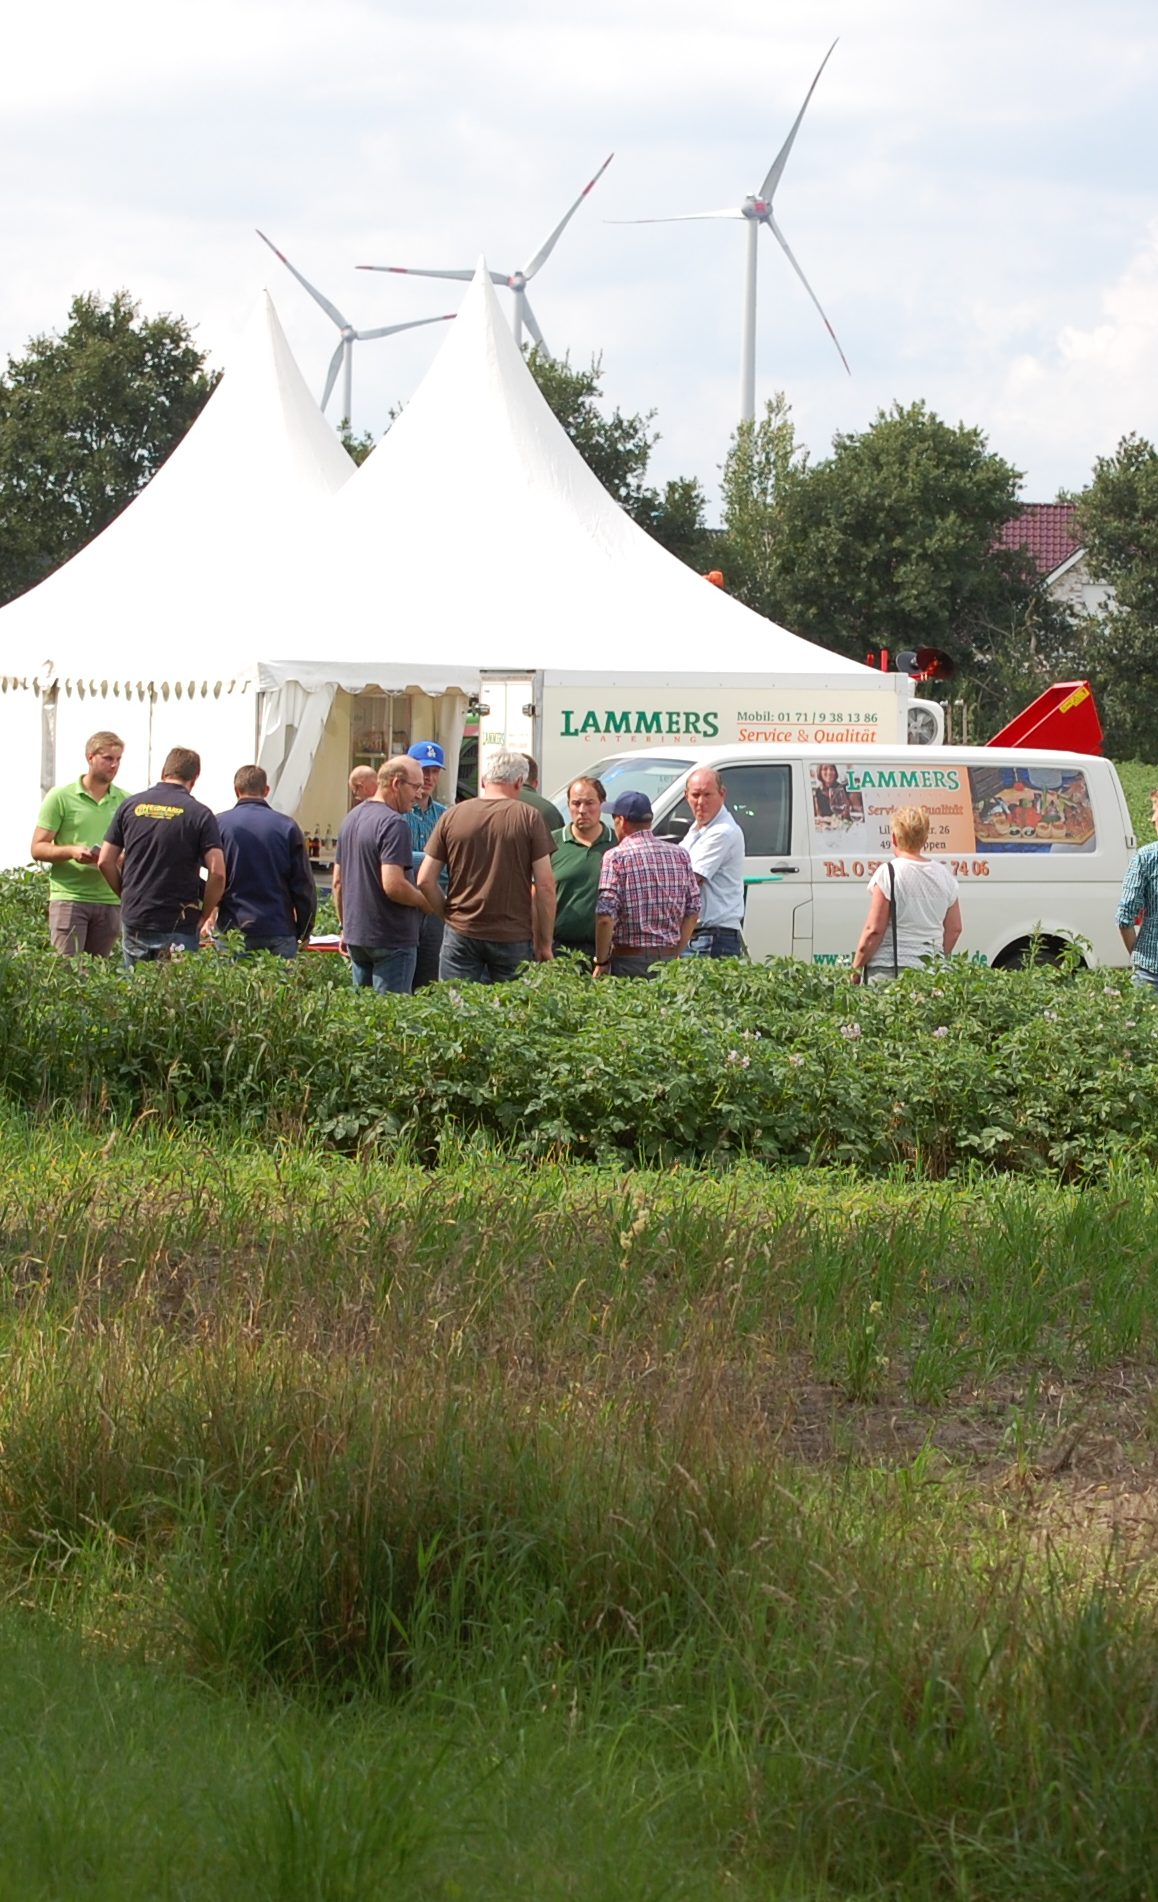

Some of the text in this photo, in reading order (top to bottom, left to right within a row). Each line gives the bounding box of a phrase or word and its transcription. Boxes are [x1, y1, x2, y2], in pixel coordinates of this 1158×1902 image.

[560, 710, 719, 738] LAMMERS
[737, 711, 775, 722] Mobil:
[777, 712, 791, 722] 01
[795, 712, 808, 722] 71
[819, 712, 826, 723] 9
[830, 713, 844, 723] 38
[848, 713, 861, 723] 13
[864, 713, 878, 723] 86
[584, 734, 697, 743] CATERING
[738, 728, 876, 744] Service & Qualität
[846, 770, 960, 791] LAMMERS
[938, 825, 950, 835] 26
[923, 842, 946, 852] ppen
[823, 860, 850, 878] Tel.
[852, 861, 865, 877] 0
[951, 861, 969, 876] 74
[972, 861, 990, 877] 06
